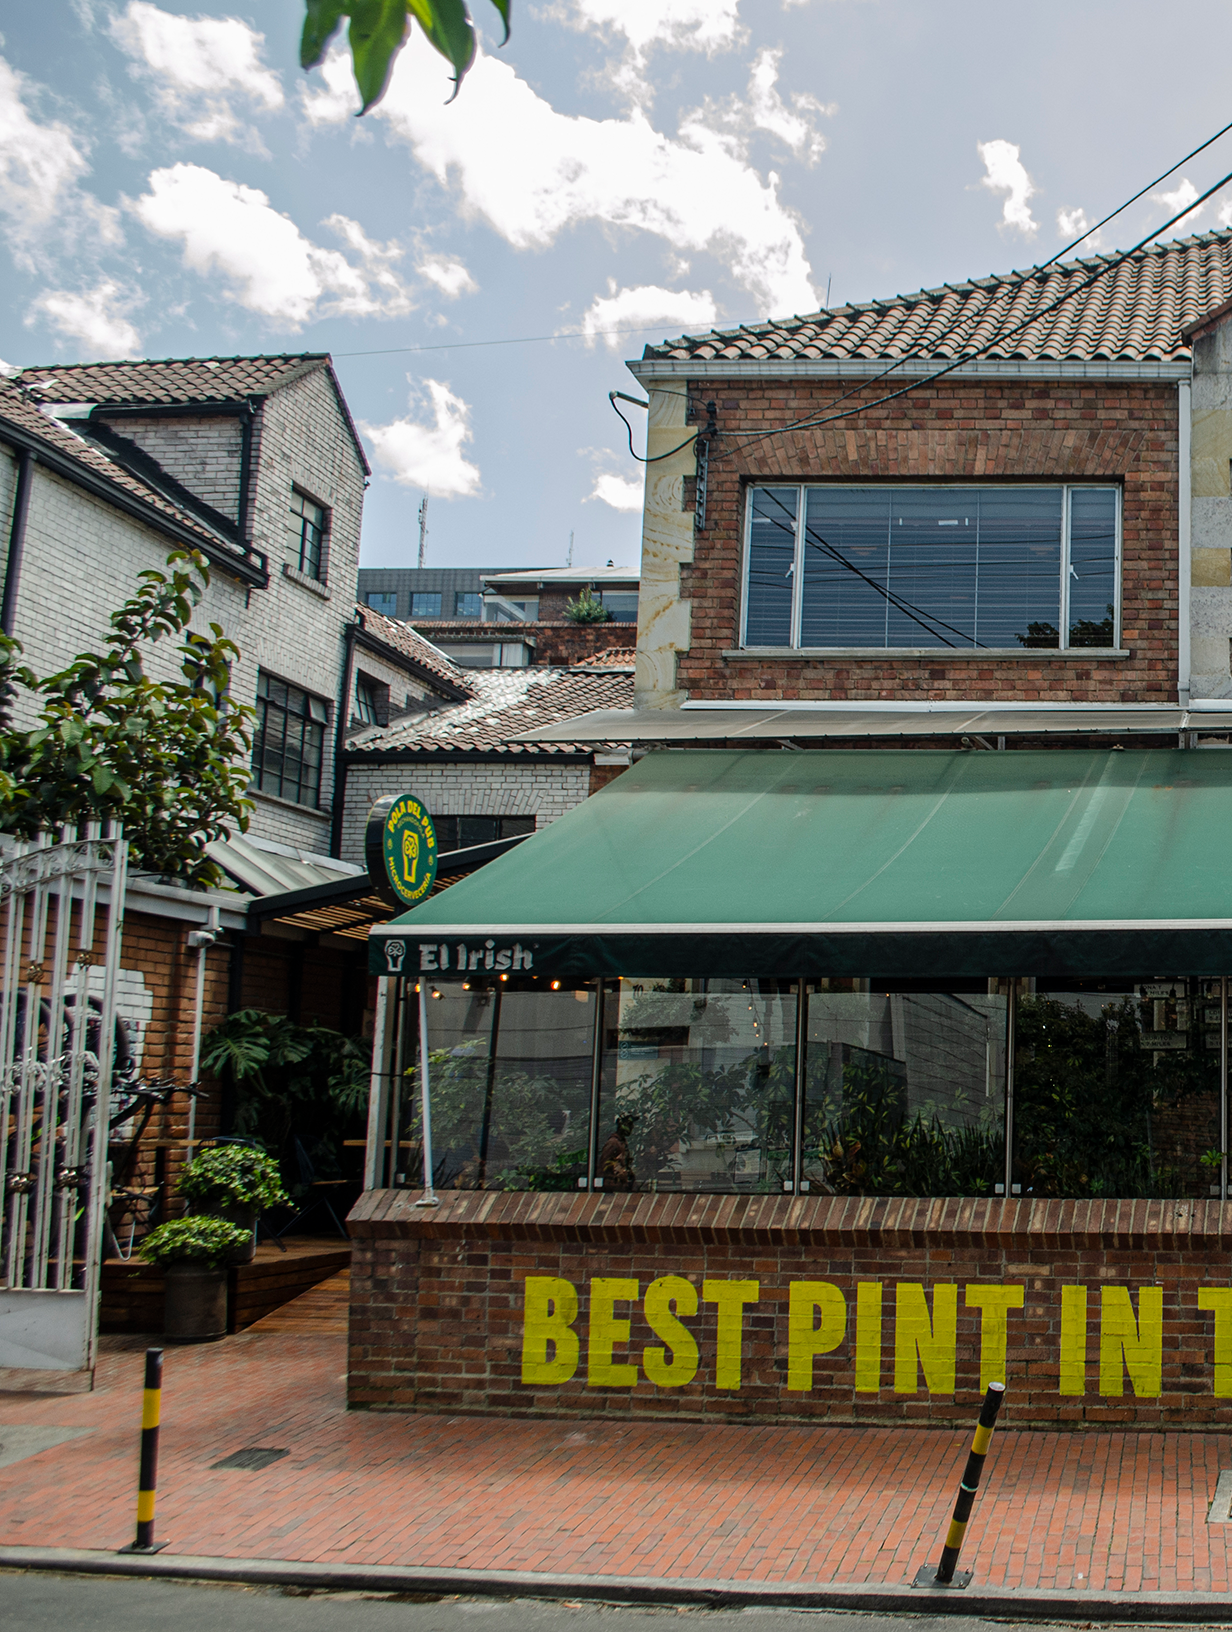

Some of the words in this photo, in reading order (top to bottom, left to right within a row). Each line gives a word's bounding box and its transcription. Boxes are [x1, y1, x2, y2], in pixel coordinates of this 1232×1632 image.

[387, 801, 406, 833] POLA
[407, 800, 421, 819] DEL
[421, 816, 435, 848] PUB
[419, 943, 450, 970] El
[456, 939, 534, 970] Irish
[521, 1276, 760, 1390] BEST
[787, 1280, 1024, 1396] PINT
[1059, 1285, 1164, 1398] IN
